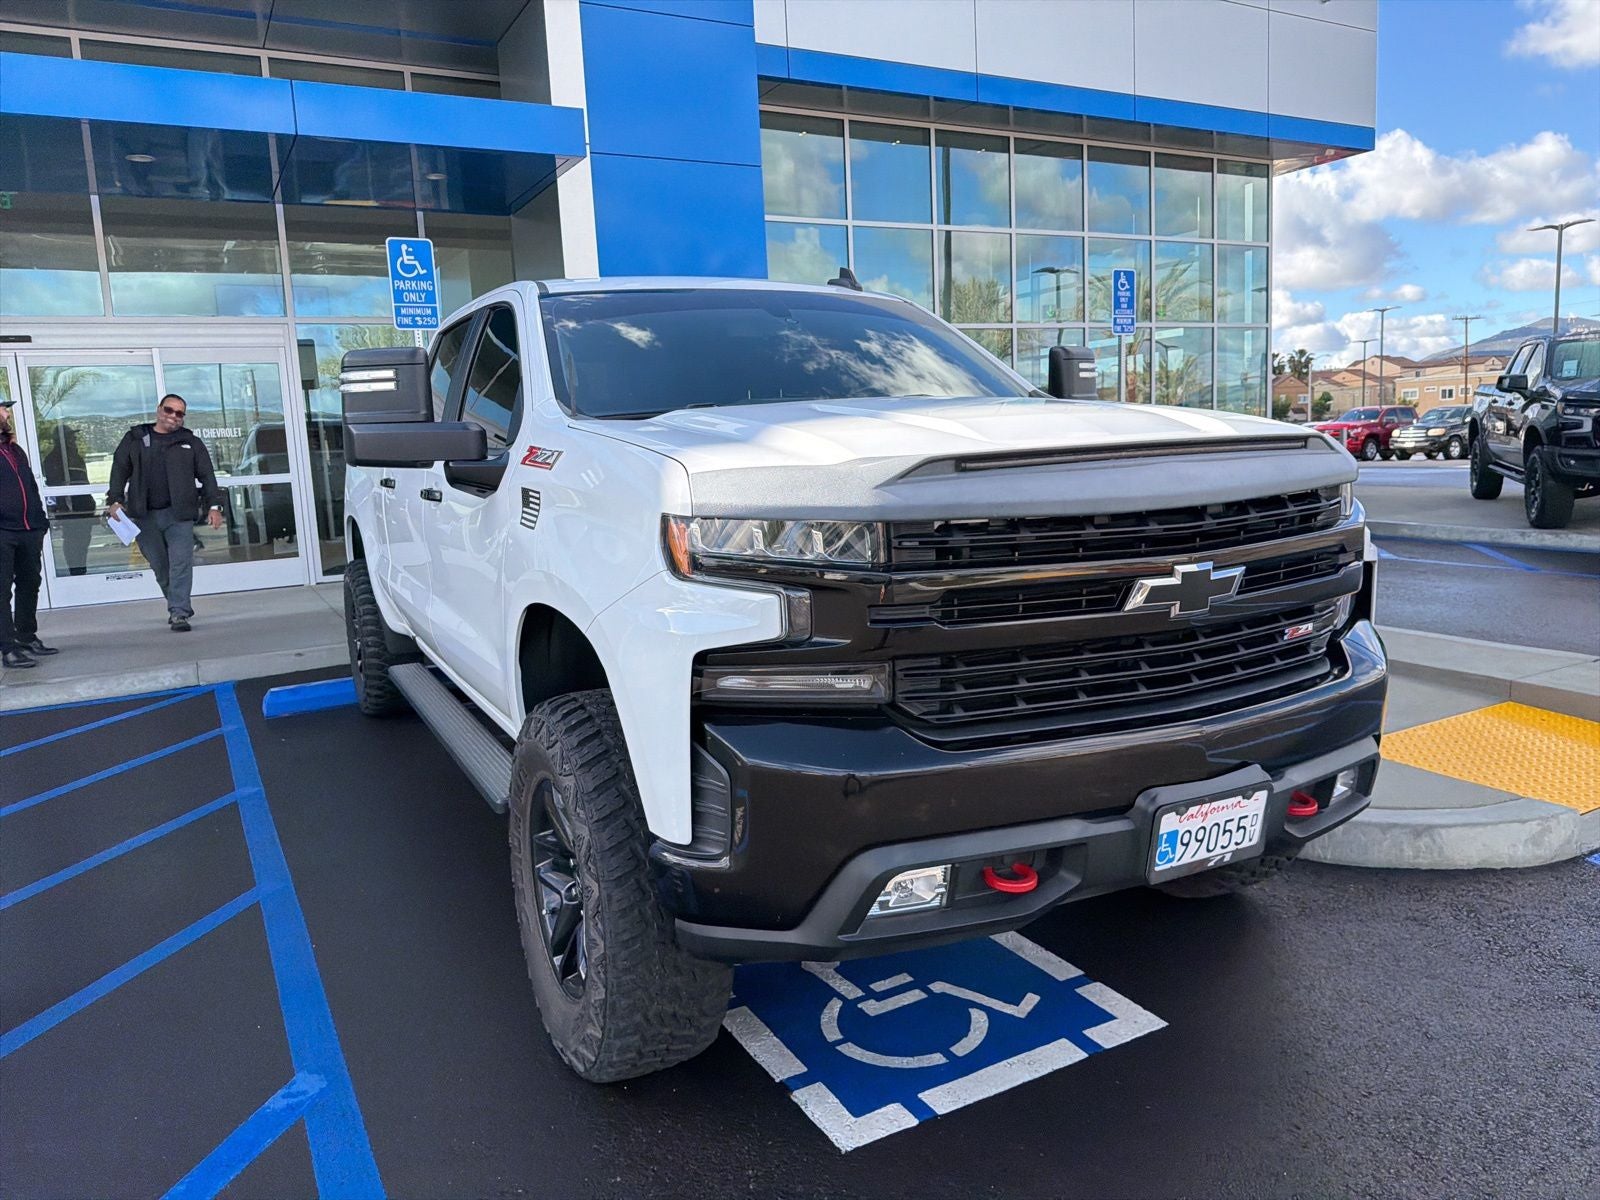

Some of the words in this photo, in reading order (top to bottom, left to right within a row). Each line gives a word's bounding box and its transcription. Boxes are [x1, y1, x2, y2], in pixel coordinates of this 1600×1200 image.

[394, 280, 433, 291] PARKING
[403, 292, 426, 302] ONLY
[401, 307, 432, 315] MINIMUM
[397, 317, 413, 325] FINE
[415, 316, 437, 325] $250
[203, 427, 242, 438] CHEVROLET
[521, 445, 564, 470] Z71
[1179, 800, 1248, 823] California
[1177, 815, 1249, 862] 99055
